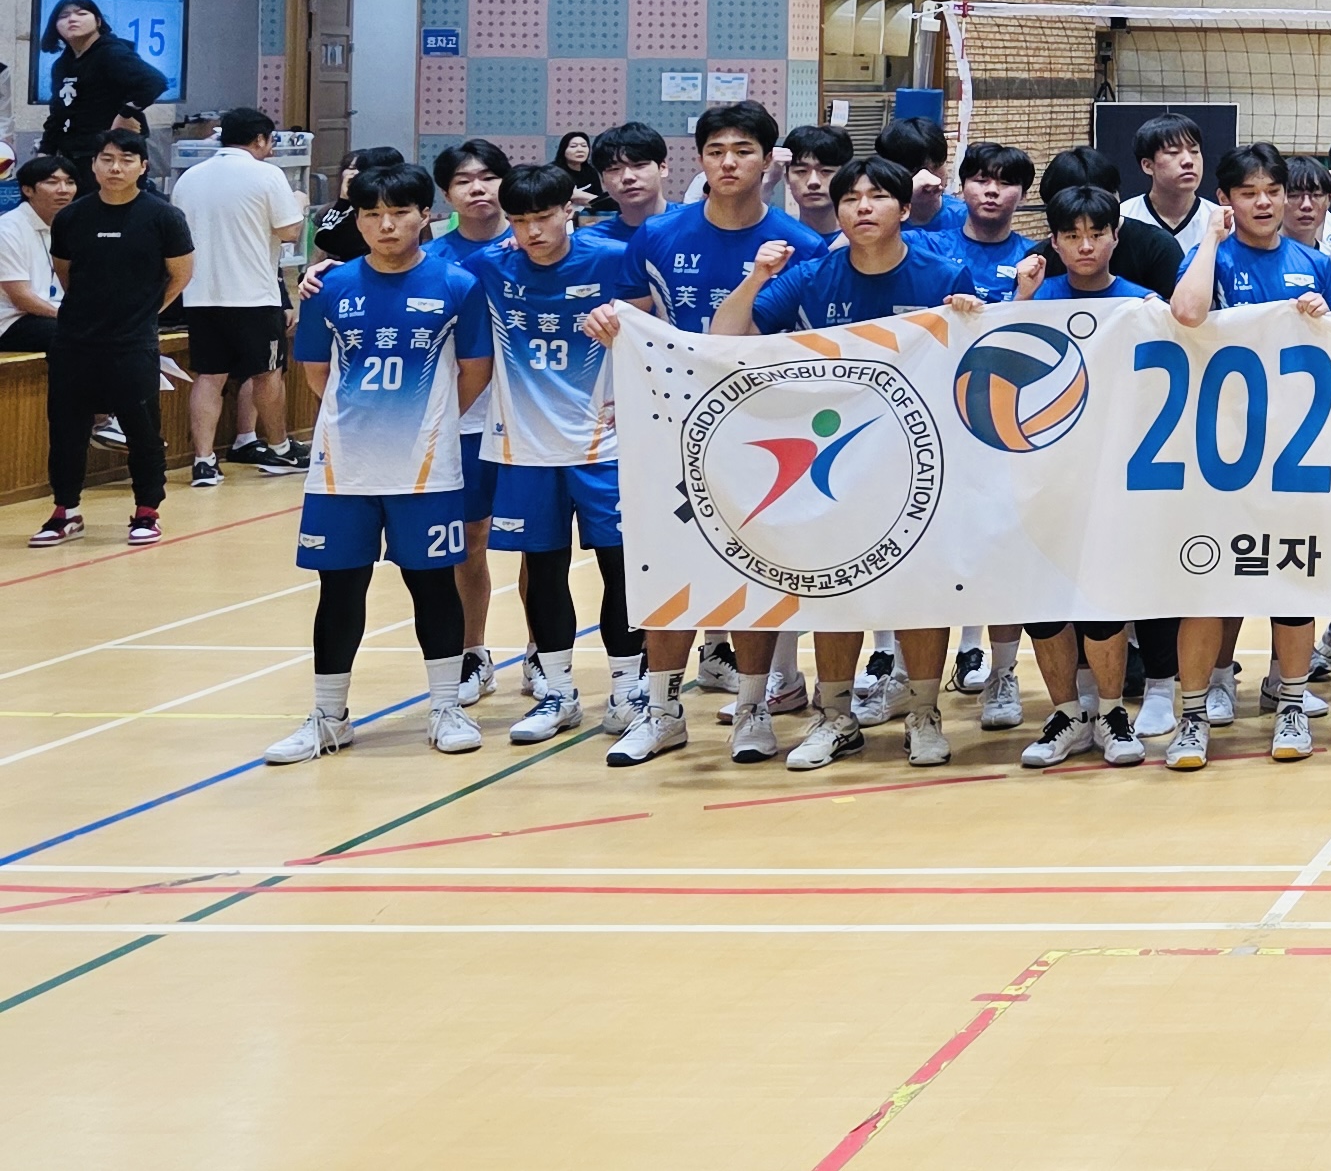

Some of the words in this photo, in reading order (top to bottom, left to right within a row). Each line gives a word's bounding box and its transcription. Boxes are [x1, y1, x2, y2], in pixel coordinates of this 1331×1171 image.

[129, 18, 166, 57] 15
[426, 36, 457, 48] 효자고
[674, 253, 702, 268] B.Y
[339, 296, 366, 313] B.Y
[826, 302, 852, 318] B.Y
[528, 338, 569, 371] 33
[360, 356, 404, 391] 20
[686, 398, 726, 518] GYEONGGIDO
[720, 365, 826, 404] UIJEONGBU
[832, 365, 896, 393] OFFICE
[890, 387, 913, 410] OF
[904, 409, 935, 520] EDUCATION
[427, 520, 465, 558] 20
[1230, 533, 1321, 577] 일자
[725, 537, 902, 592] 경기도의정부교육지원청
